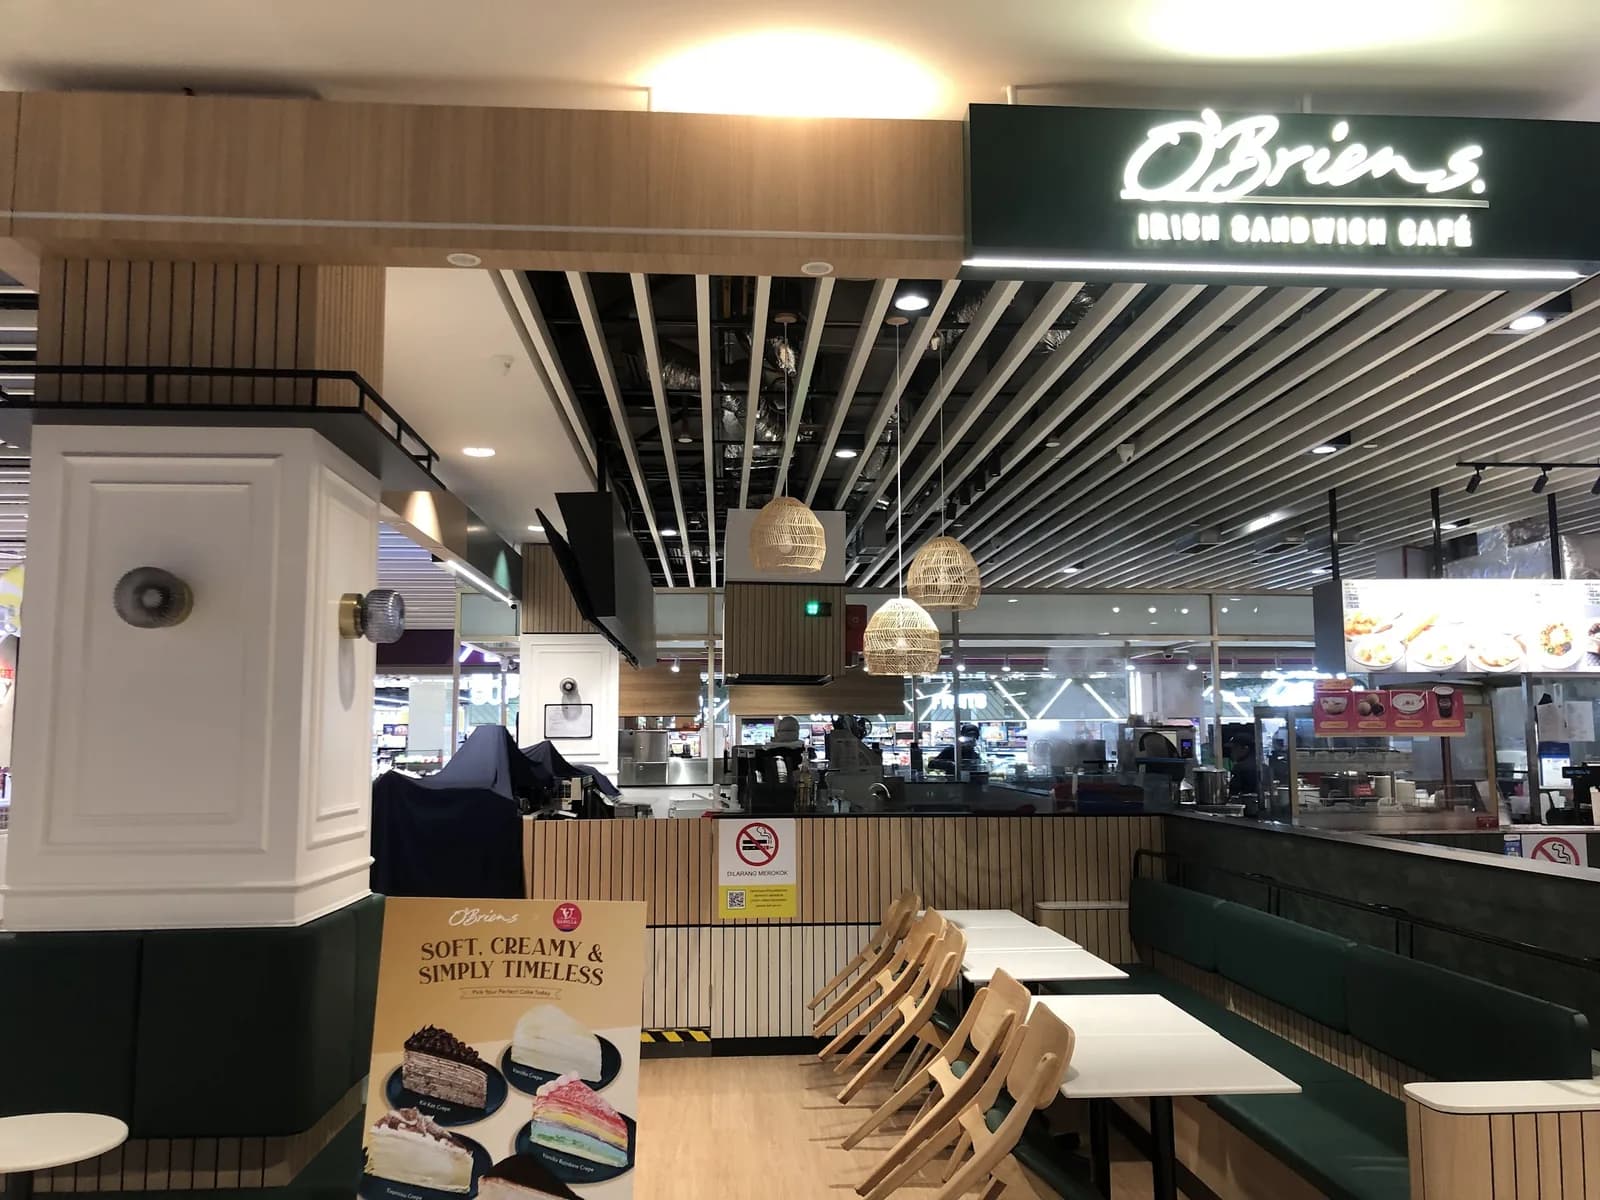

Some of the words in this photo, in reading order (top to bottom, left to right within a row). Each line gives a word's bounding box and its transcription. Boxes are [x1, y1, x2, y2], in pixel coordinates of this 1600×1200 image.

[1137, 212, 1221, 242] IRISH
[1230, 214, 1388, 246] SANDWICH
[490, 936, 583, 959] CREAMY
[588, 943, 604, 963] &
[418, 960, 495, 985] SIMPLY
[502, 960, 604, 986] TIMELESS
